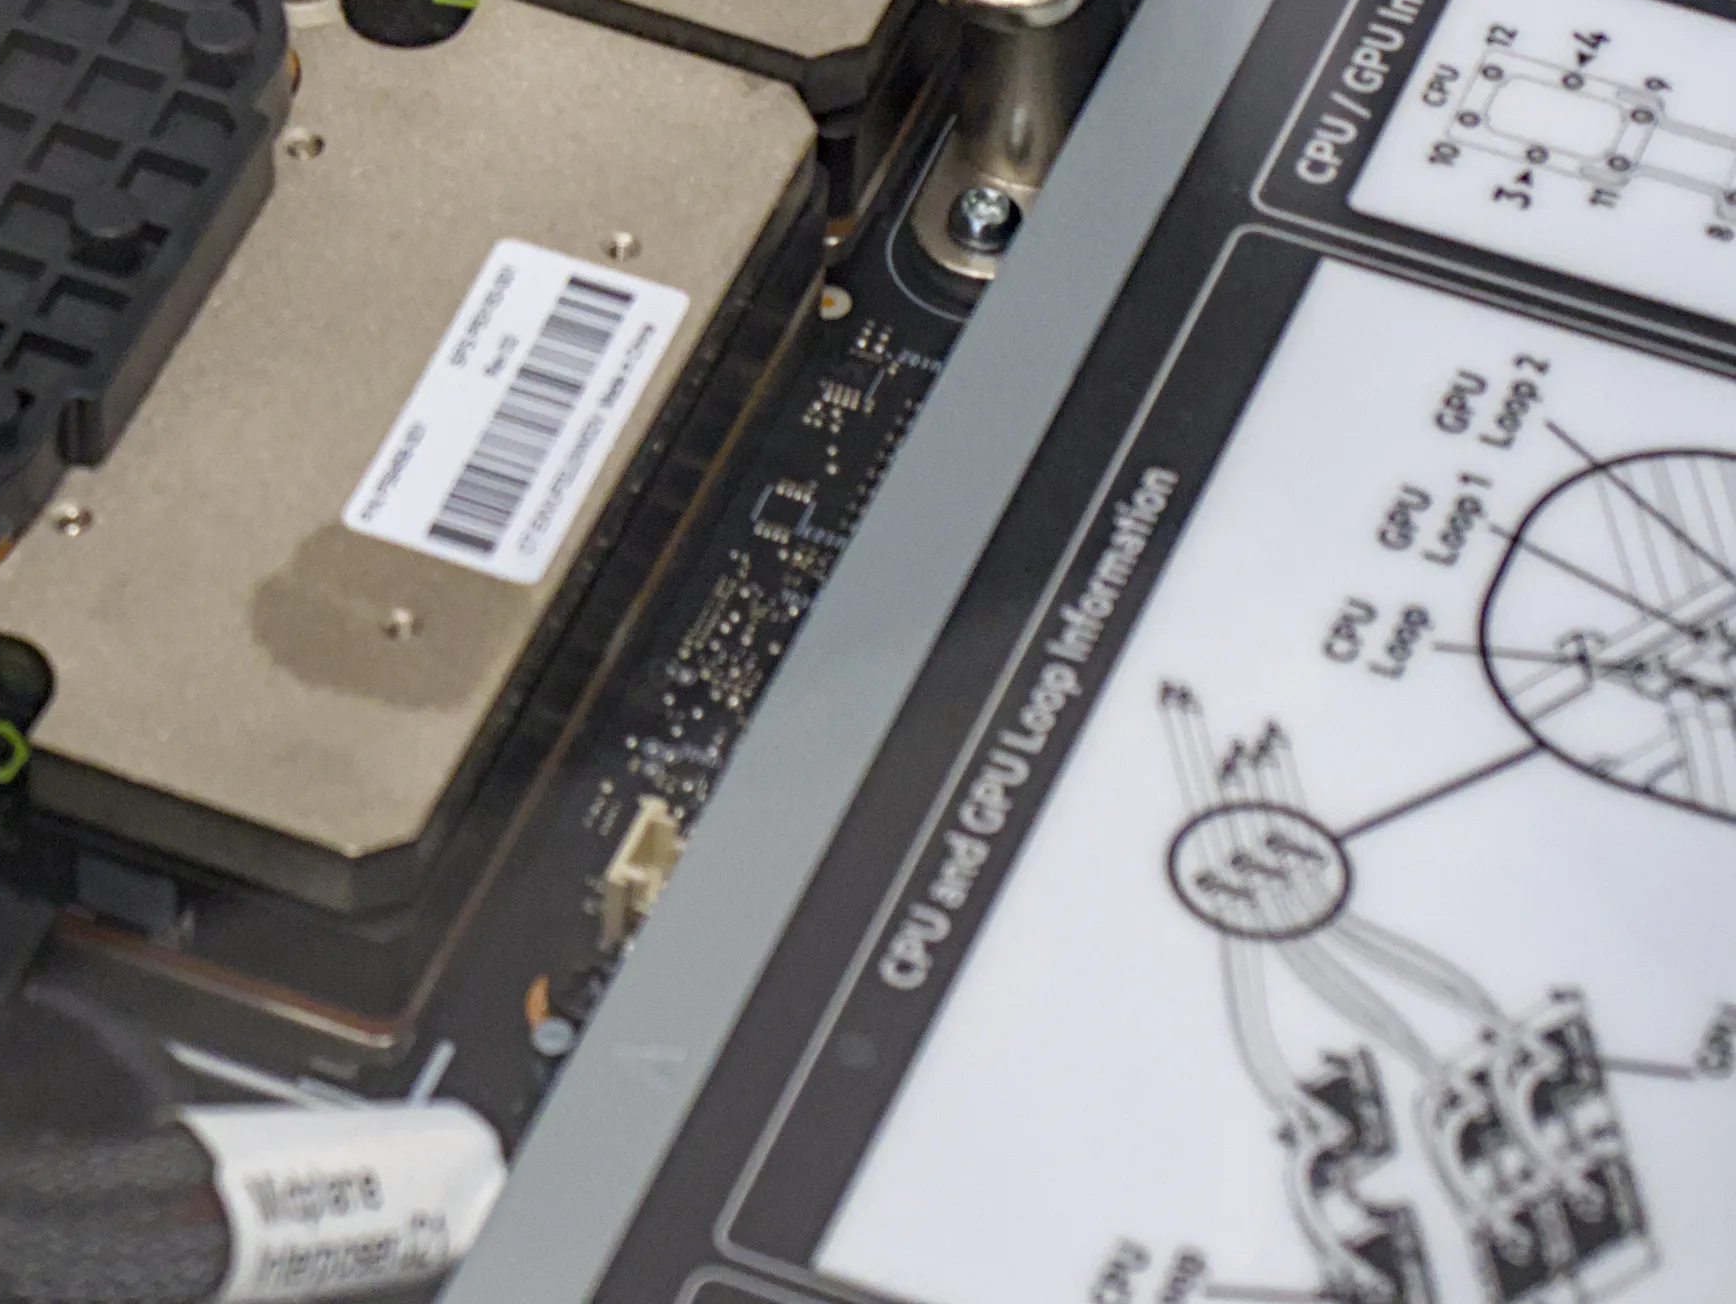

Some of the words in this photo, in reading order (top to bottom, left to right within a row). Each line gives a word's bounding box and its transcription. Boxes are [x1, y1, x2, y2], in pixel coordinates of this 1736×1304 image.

[1341, 21, 1406, 96] GPU
[1485, 22, 1519, 48] 12
[1572, 29, 1612, 51] 4
[1342, 91, 1373, 120] /
[1420, 61, 1460, 108] CPU
[1295, 108, 1359, 185] CPU
[1428, 141, 1461, 167] 10
[1492, 186, 1533, 211] 3
[1433, 368, 1489, 435] GPU
[1477, 379, 1543, 450] Loop
[1513, 352, 1551, 376] 2
[1377, 483, 1434, 551] GPU
[1421, 494, 1488, 567] Loop
[1457, 471, 1494, 489] 1
[1046, 465, 1180, 663] Information
[1321, 596, 1378, 664] CPU
[1367, 603, 1435, 679] Loop
[1007, 661, 1083, 755] Loop
[958, 729, 1031, 835] GPU
[929, 826, 991, 910] and
[879, 901, 952, 990] CPU
